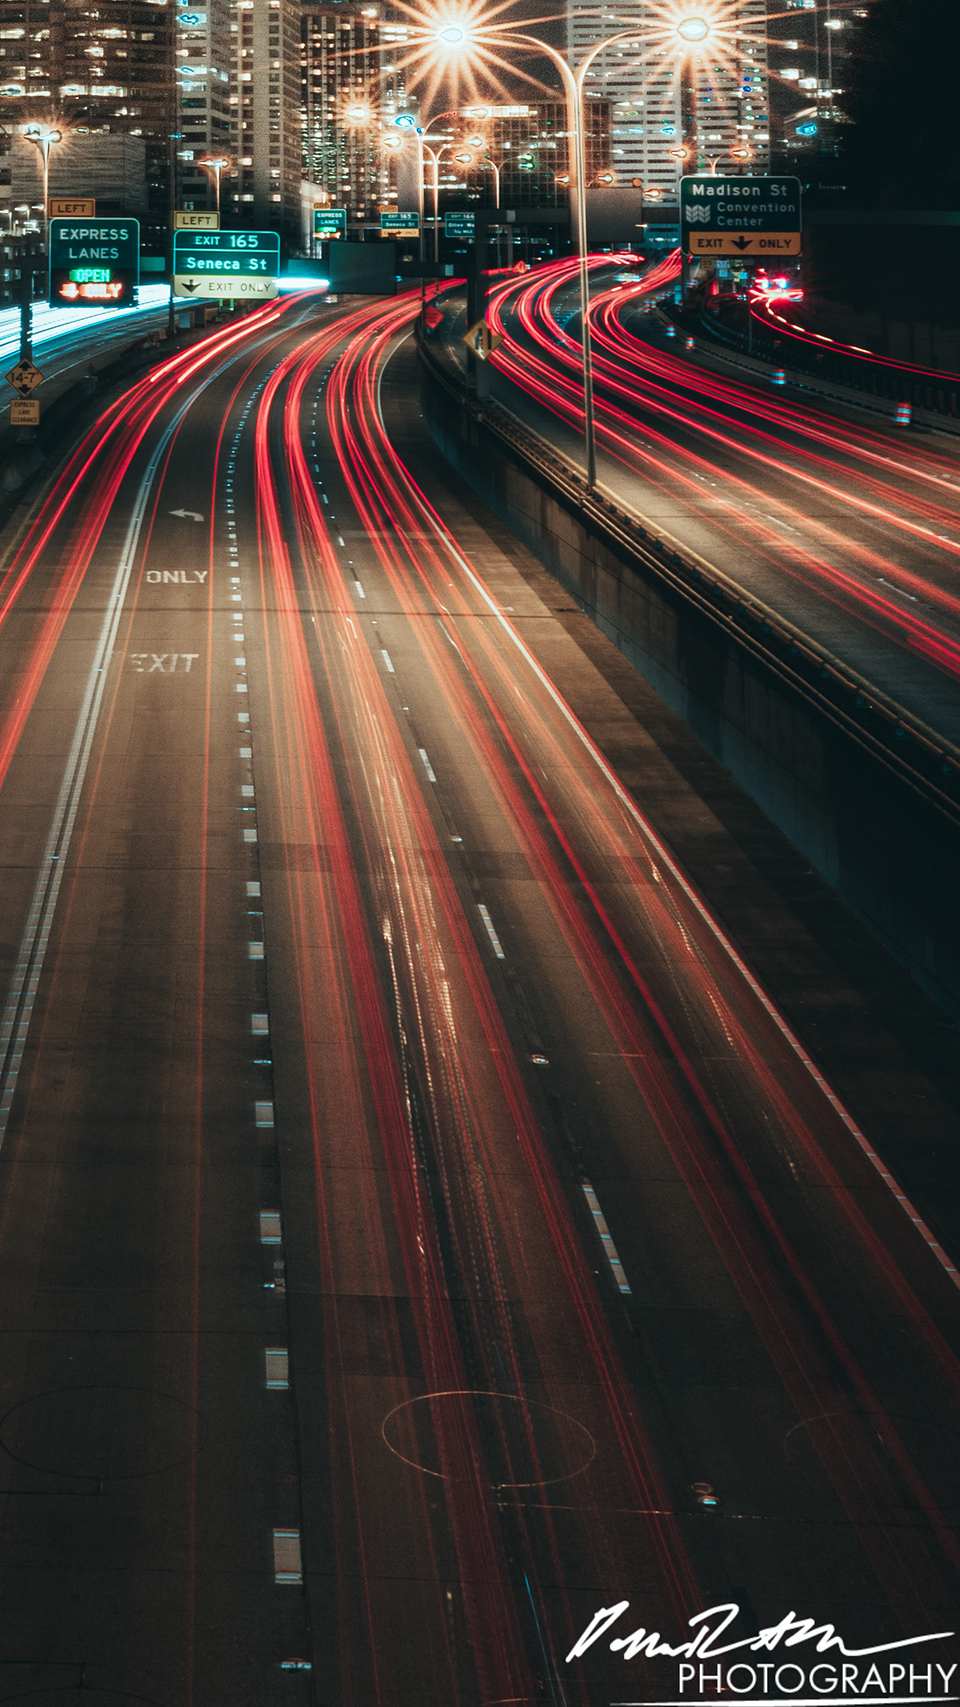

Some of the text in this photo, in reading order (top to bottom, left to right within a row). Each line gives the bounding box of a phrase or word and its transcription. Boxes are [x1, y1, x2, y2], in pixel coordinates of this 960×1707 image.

[692, 184, 788, 196] Madison St
[57, 204, 87, 213] LEFT
[717, 201, 796, 212] Convention
[182, 216, 212, 225] LEFT
[717, 215, 764, 226] Center
[60, 228, 129, 240] EXPRESS
[195, 234, 259, 248] EXIT 165
[697, 238, 792, 248] EXIT ONLY
[69, 247, 120, 259] LANES
[186, 256, 268, 270] Seneca St
[75, 269, 111, 283] OPEN
[208, 282, 234, 291] EXIT
[146, 570, 208, 584] ONLY
[130, 653, 199, 672] EXIT
